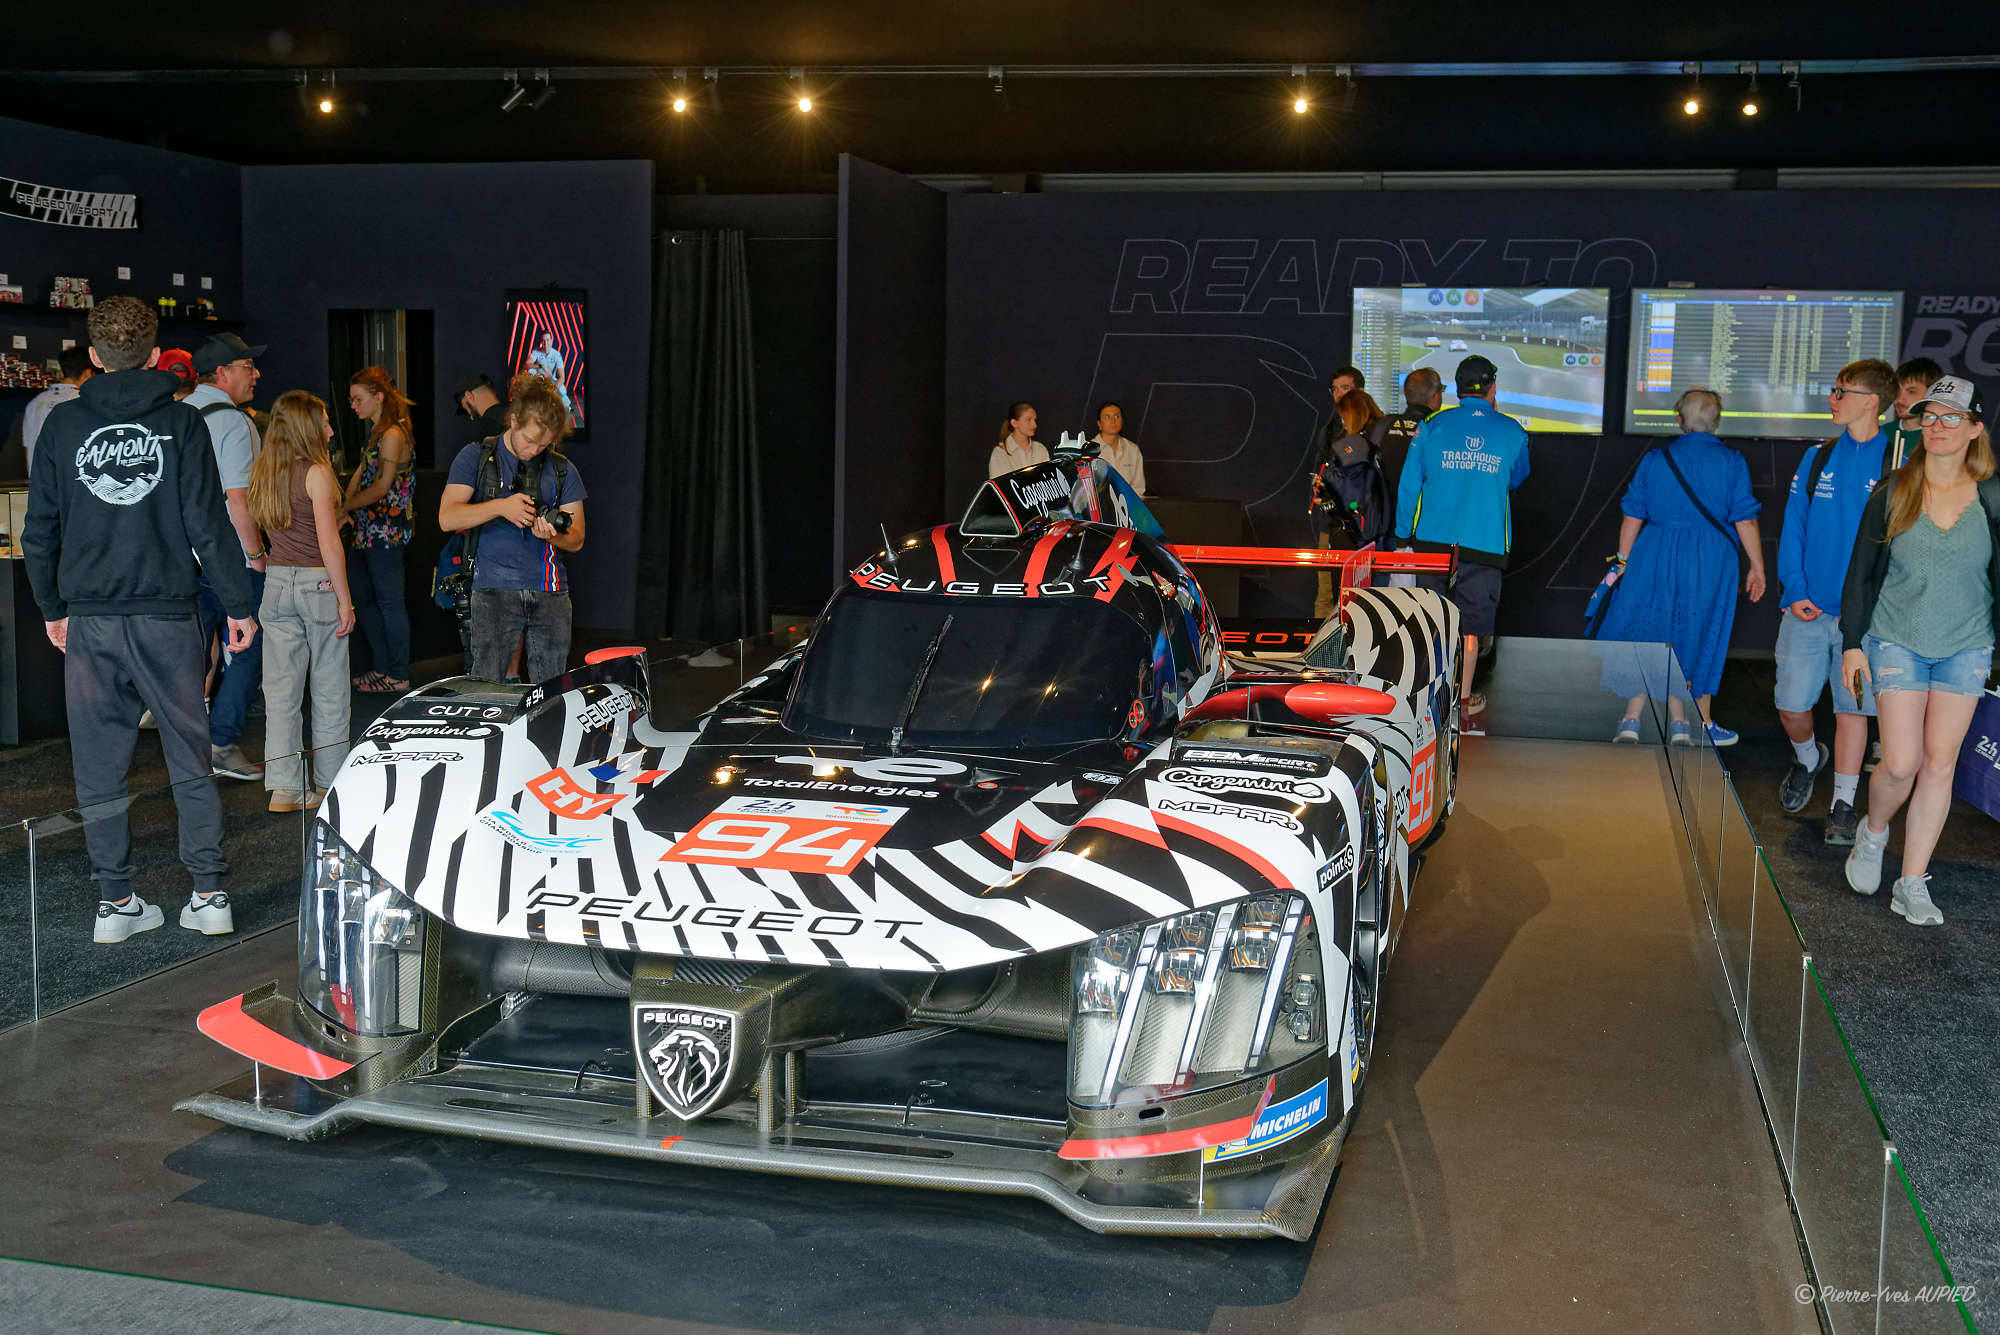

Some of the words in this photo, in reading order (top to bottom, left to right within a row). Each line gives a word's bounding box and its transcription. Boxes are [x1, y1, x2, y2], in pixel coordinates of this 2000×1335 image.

[16, 191, 73, 210] PEUGEOT
[77, 206, 113, 217] SPORT
[1111, 239, 1486, 313] READY
[1441, 450, 1501, 465] TRACKHOUSE
[1441, 460, 1475, 470] MOTOGP
[1477, 461, 1500, 474] TEAM
[855, 562, 1111, 596] PEUGEOT
[428, 705, 480, 717] CUT
[526, 686, 544, 708] #94
[575, 690, 637, 733] PEUGEOT
[365, 725, 467, 739] Capgemini
[351, 751, 456, 767] MOPAR
[538, 776, 617, 814] HY
[743, 777, 940, 799] TotalEnergies
[1168, 771, 1292, 794] Capgemini
[1410, 752, 1434, 831] 93
[1158, 799, 1288, 827] MOPAR
[479, 819, 542, 854] CHAMPIONSHIP
[678, 819, 868, 868] 94
[1320, 857, 1344, 889] point
[527, 891, 923, 939] PEUGEOT
[643, 1012, 727, 1030] PEUGEOT
[1251, 1096, 1321, 1140] MICHELIN
